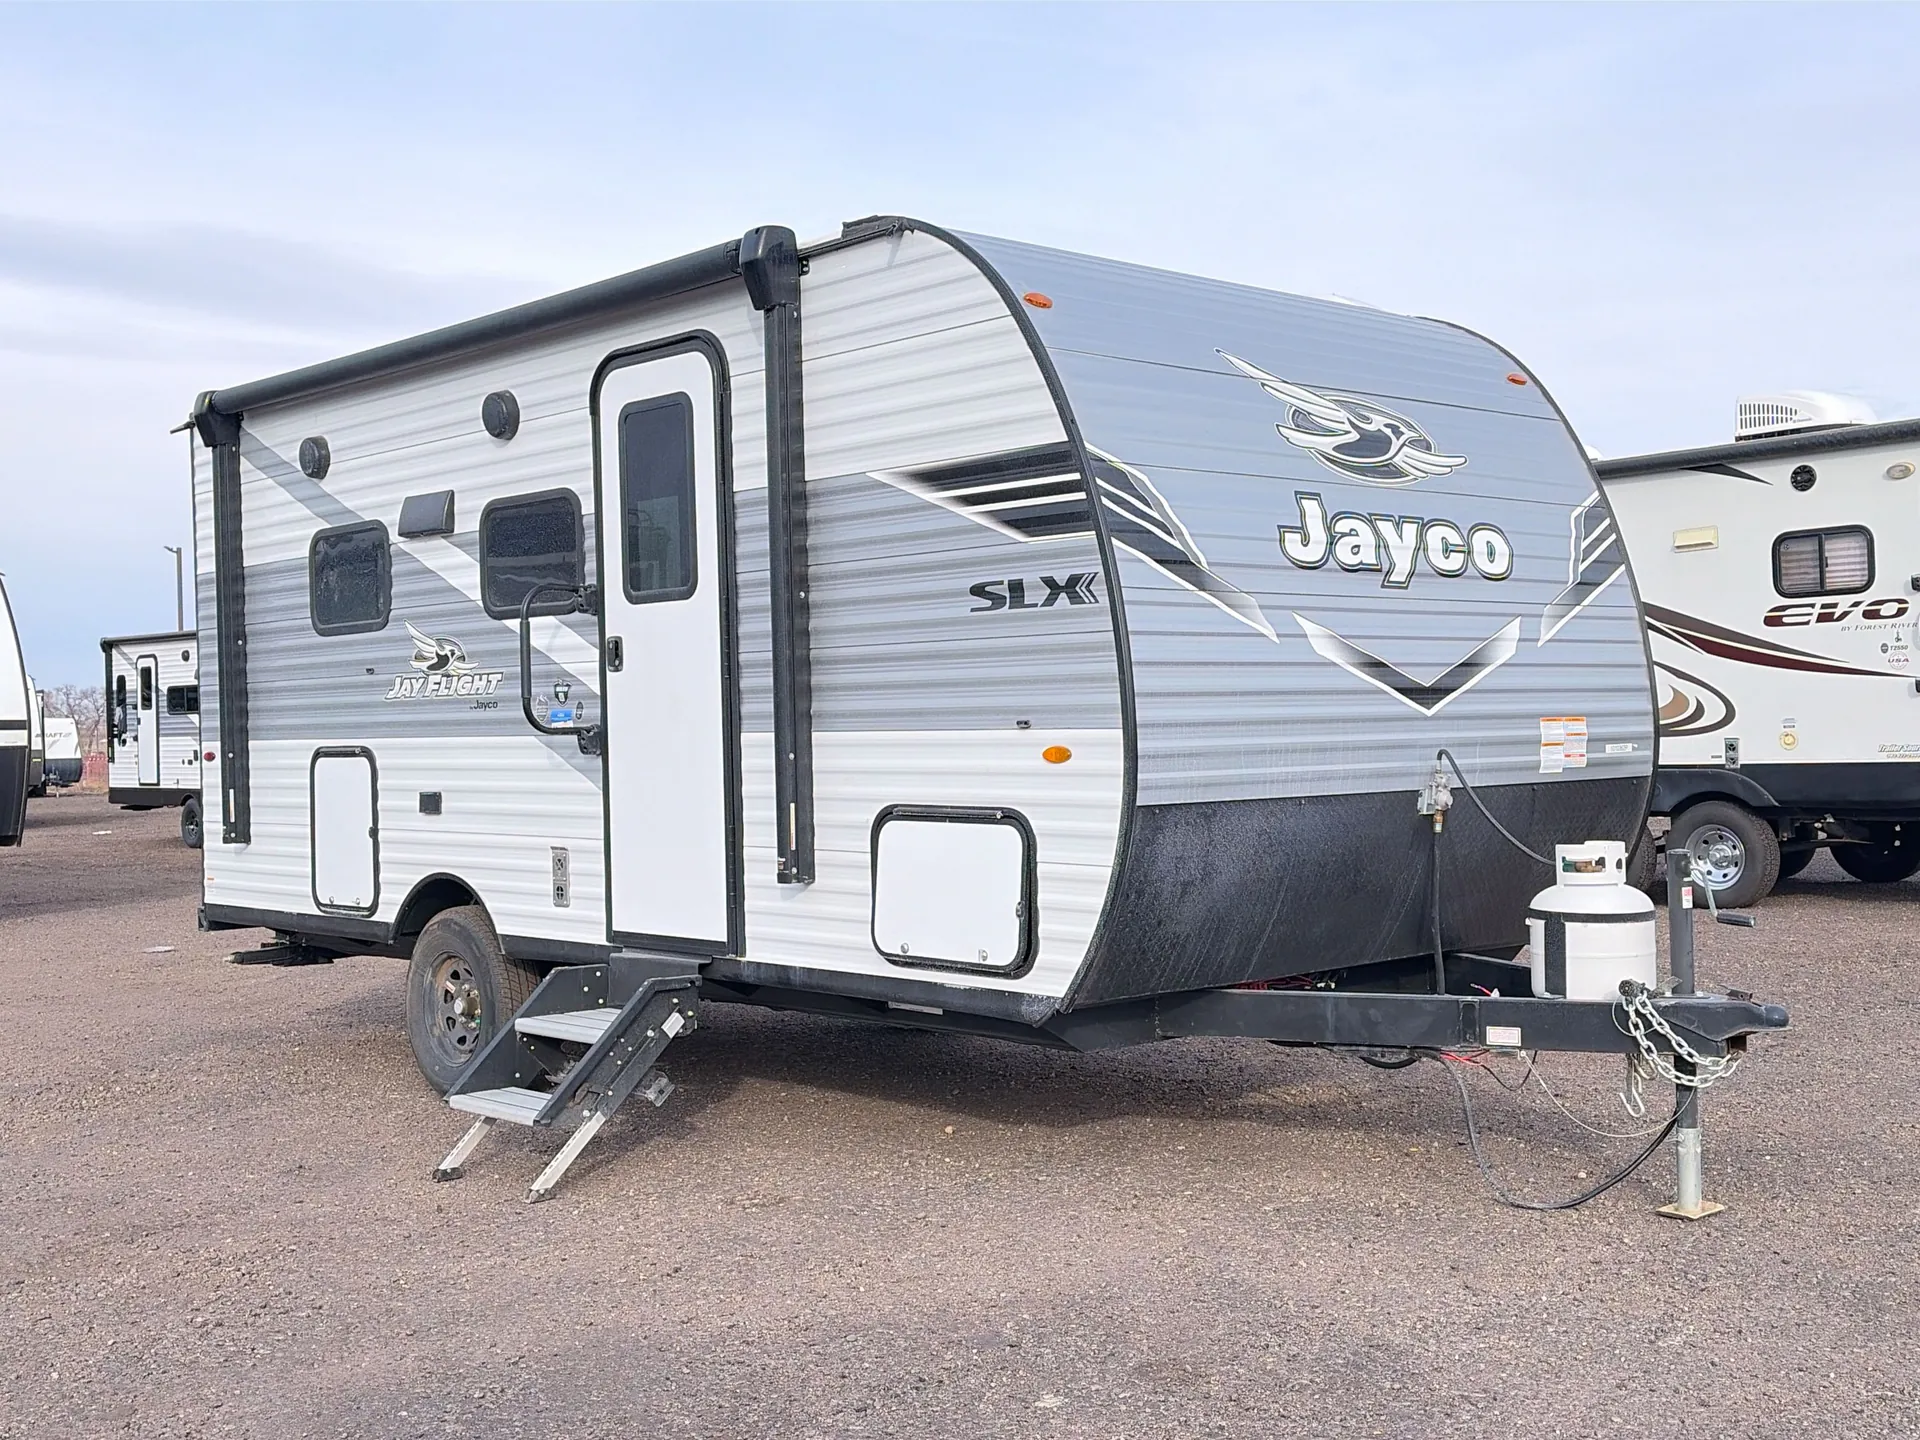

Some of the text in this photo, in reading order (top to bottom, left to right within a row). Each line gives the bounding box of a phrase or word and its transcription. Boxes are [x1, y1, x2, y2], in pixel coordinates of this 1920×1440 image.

[1277, 490, 1514, 590] Jayco
[969, 572, 1100, 612] SLX
[1763, 598, 1910, 627] EVO
[1890, 622, 1919, 630] RIVER
[384, 671, 505, 701] JAY FLIGHT
[473, 700, 499, 711] Jayco
